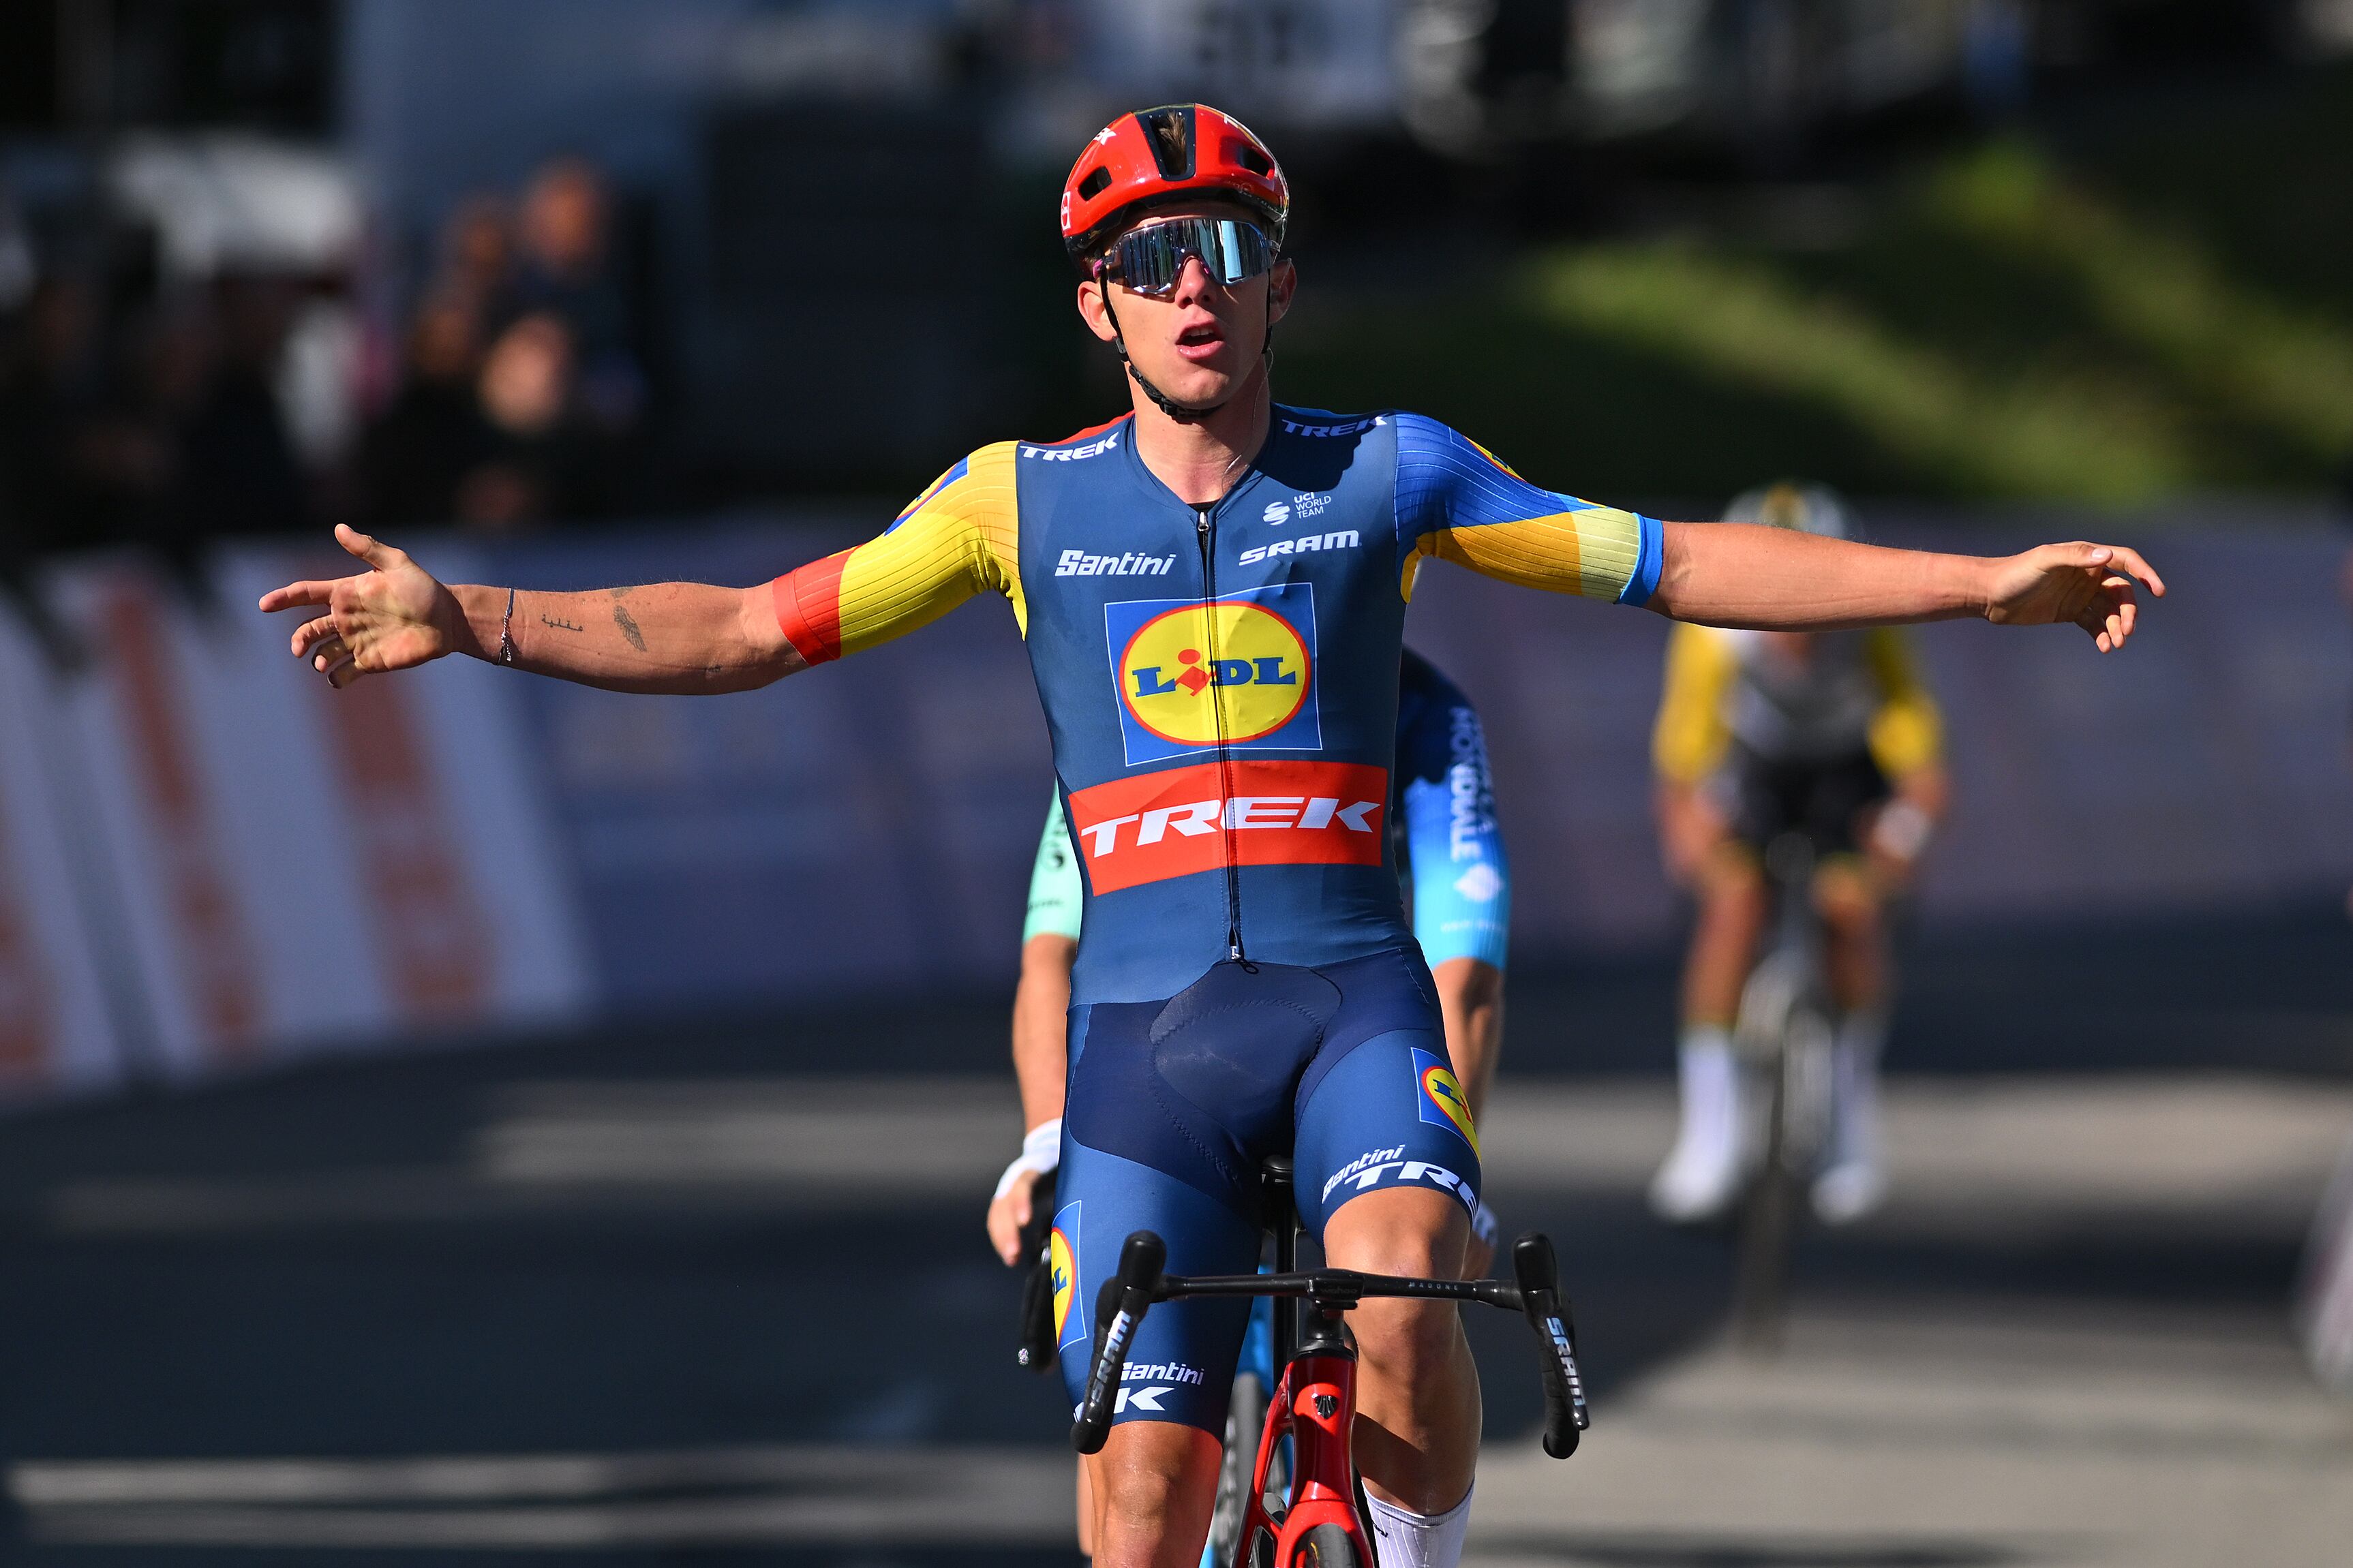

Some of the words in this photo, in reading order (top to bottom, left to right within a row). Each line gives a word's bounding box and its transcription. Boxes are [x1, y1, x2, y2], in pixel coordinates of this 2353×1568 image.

[1281, 413, 1388, 437] TREK
[1020, 432, 1119, 462] TREK
[1294, 491, 1315, 504] UCI
[1295, 495, 1332, 511] WORLD
[1296, 506, 1324, 519] TEAM
[1239, 529, 1359, 566] SRAM
[1054, 549, 1176, 577] Santini
[1080, 796, 1381, 858] TREK
[1322, 1144, 1406, 1204] Santini
[1344, 1160, 1477, 1223] TRE
[1408, 1281, 1458, 1291] MADONE
[1546, 1317, 1585, 1406] SRAM
